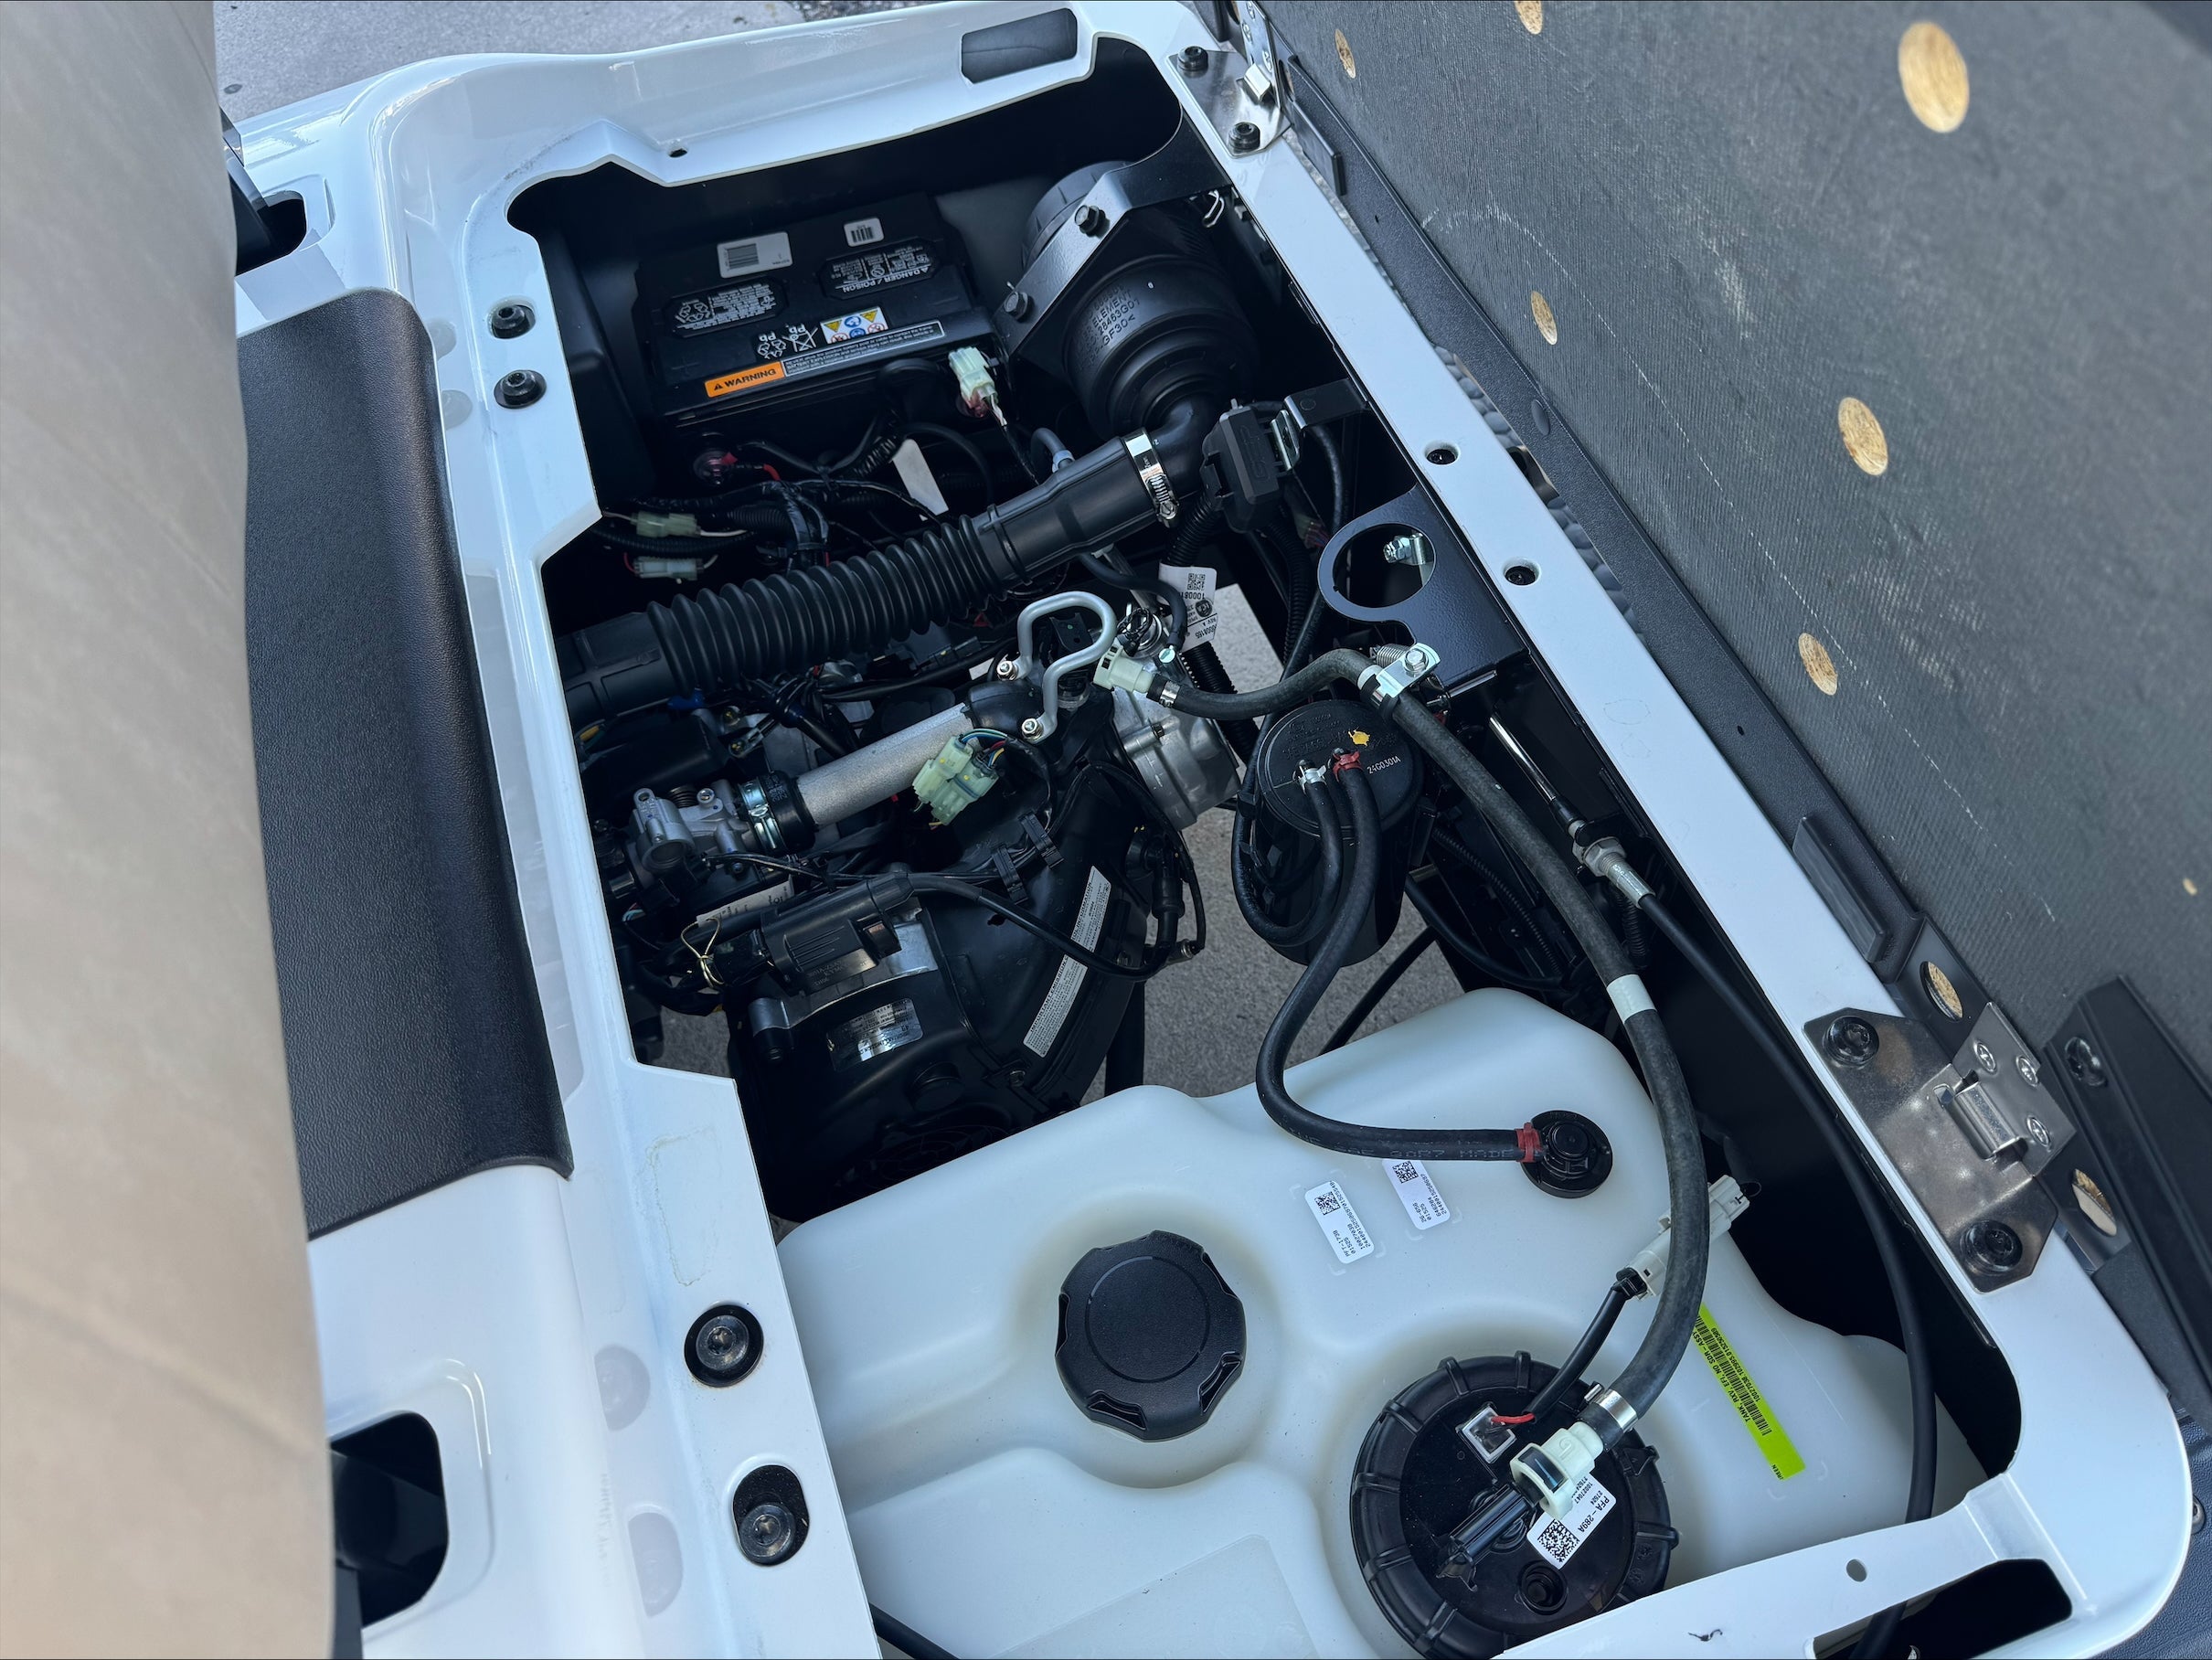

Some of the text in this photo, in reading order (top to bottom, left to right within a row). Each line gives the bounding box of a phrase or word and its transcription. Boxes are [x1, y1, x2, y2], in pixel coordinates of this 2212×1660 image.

[884, 268, 920, 283] DANGER
[842, 280, 876, 293] POISON
[1090, 289, 1133, 328] ELEMENT
[1096, 296, 1141, 335] 28463G01
[757, 330, 776, 343] Pb
[787, 323, 806, 335] Pb
[724, 367, 776, 388] WARNING
[1367, 755, 1401, 774] 24G0301A
[1711, 1364, 1722, 1374] NO
[1718, 1373, 1729, 1387] EFI,
[1735, 1401, 1751, 1422] TANK,
[1589, 1489, 1603, 1505] 27524
